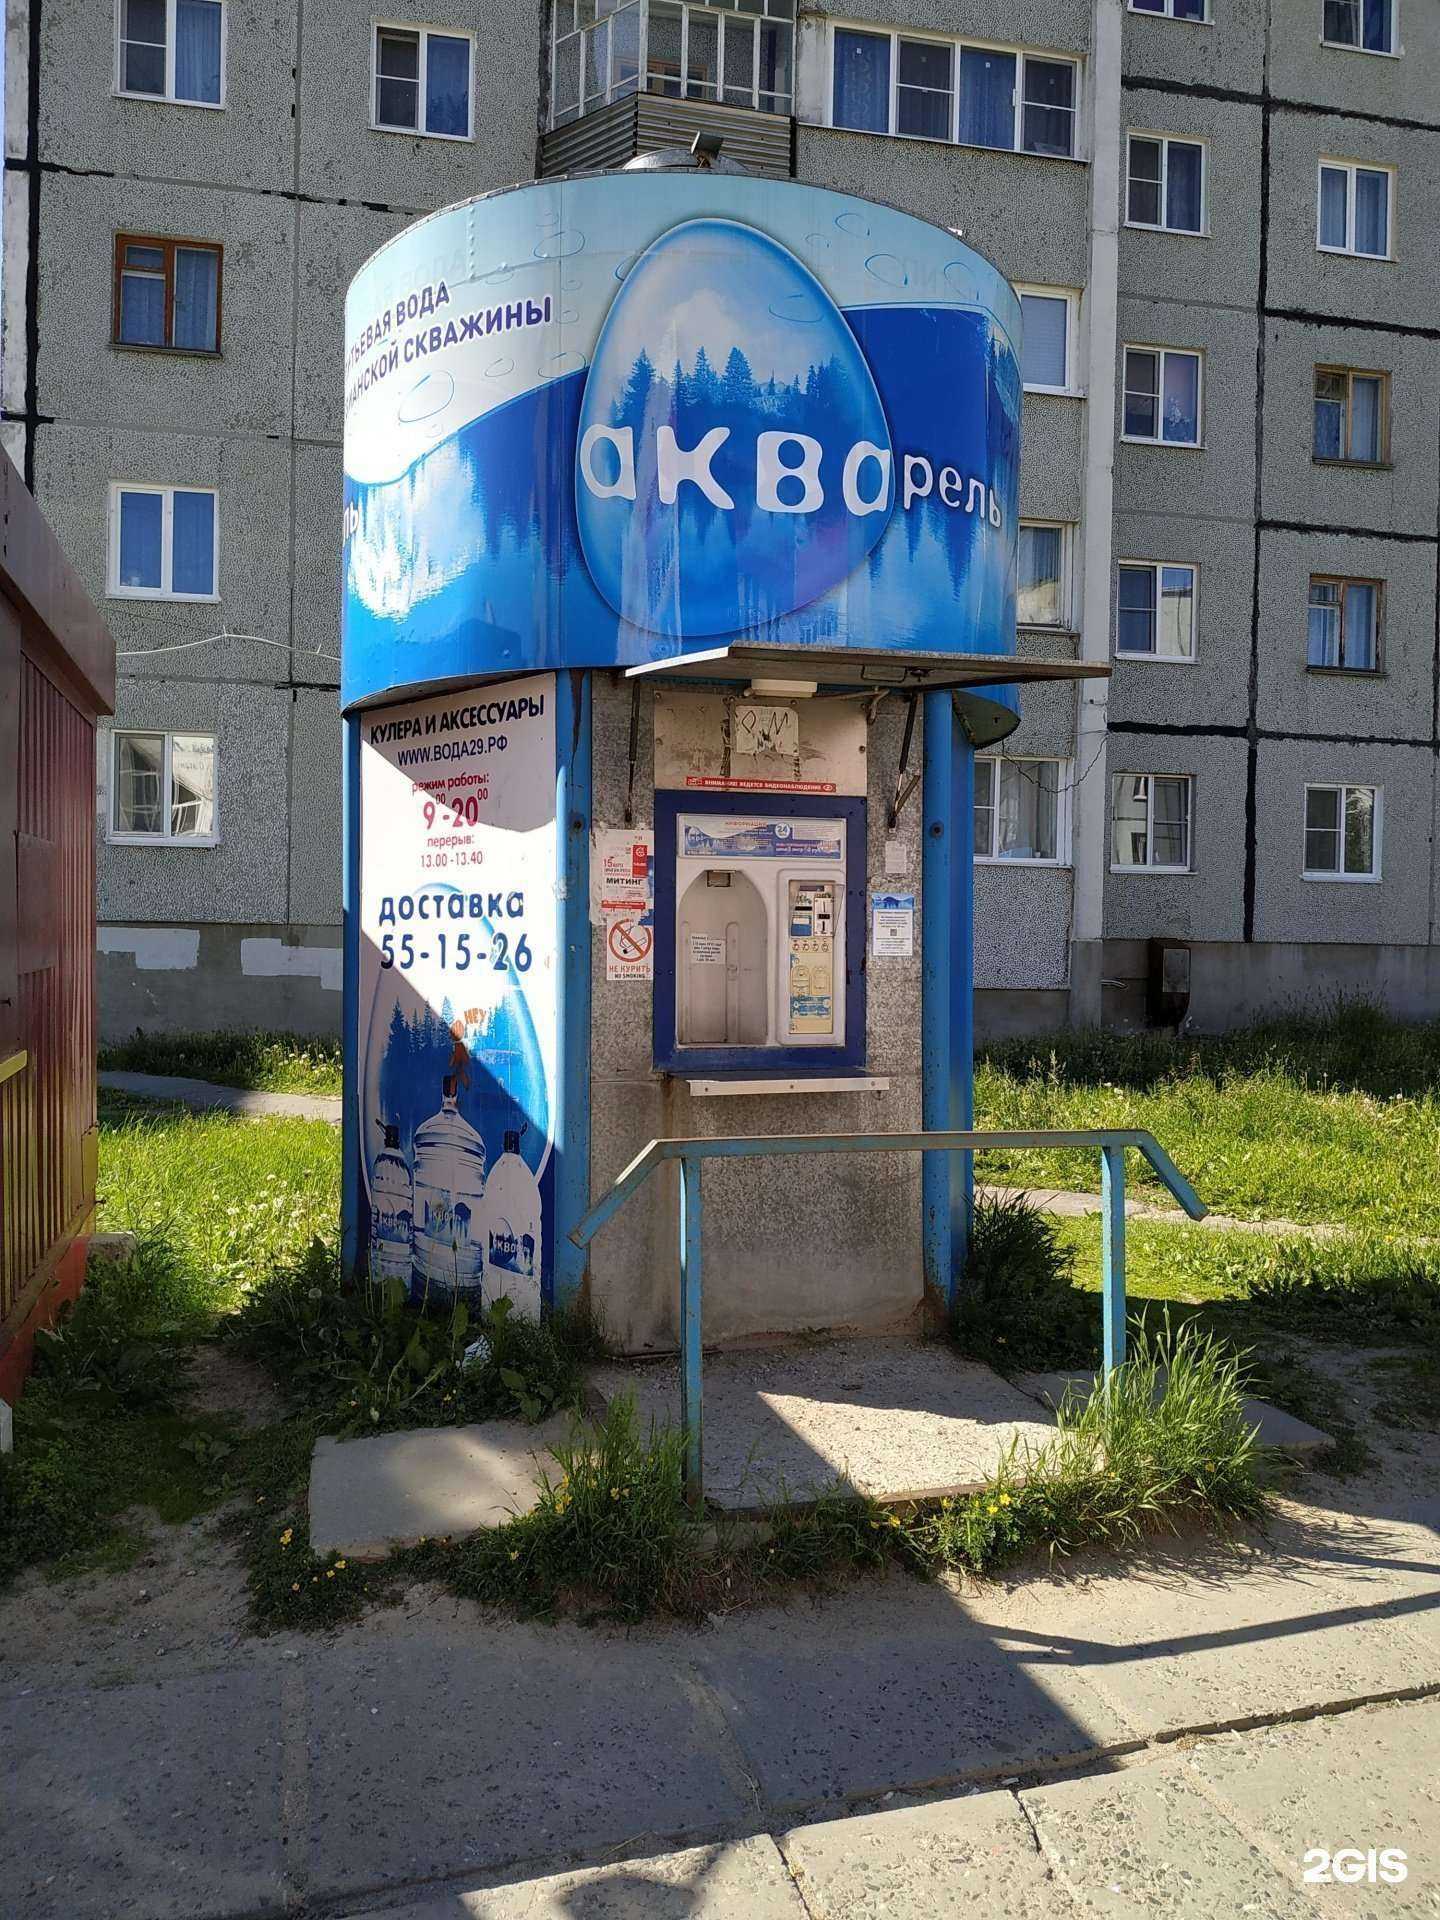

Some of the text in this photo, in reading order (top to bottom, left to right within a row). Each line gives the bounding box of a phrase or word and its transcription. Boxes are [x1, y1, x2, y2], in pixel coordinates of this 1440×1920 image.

[396, 281, 450, 327] ВОДА
[404, 296, 551, 363] СКВАЖИНЫ
[370, 694, 544, 744] КУЛЕРА И АКСЕССУАРЫ
[397, 735, 508, 766] WWW.ВОДА29.РФ
[412, 772, 490, 796] режим работы:
[427, 833, 475, 849] перерыв:
[606, 877, 643, 885] МИТИНГ
[379, 891, 524, 927] доставка
[380, 932, 532, 972] 55-15-26
[608, 964, 651, 974] НЕ КУРИТЬ
